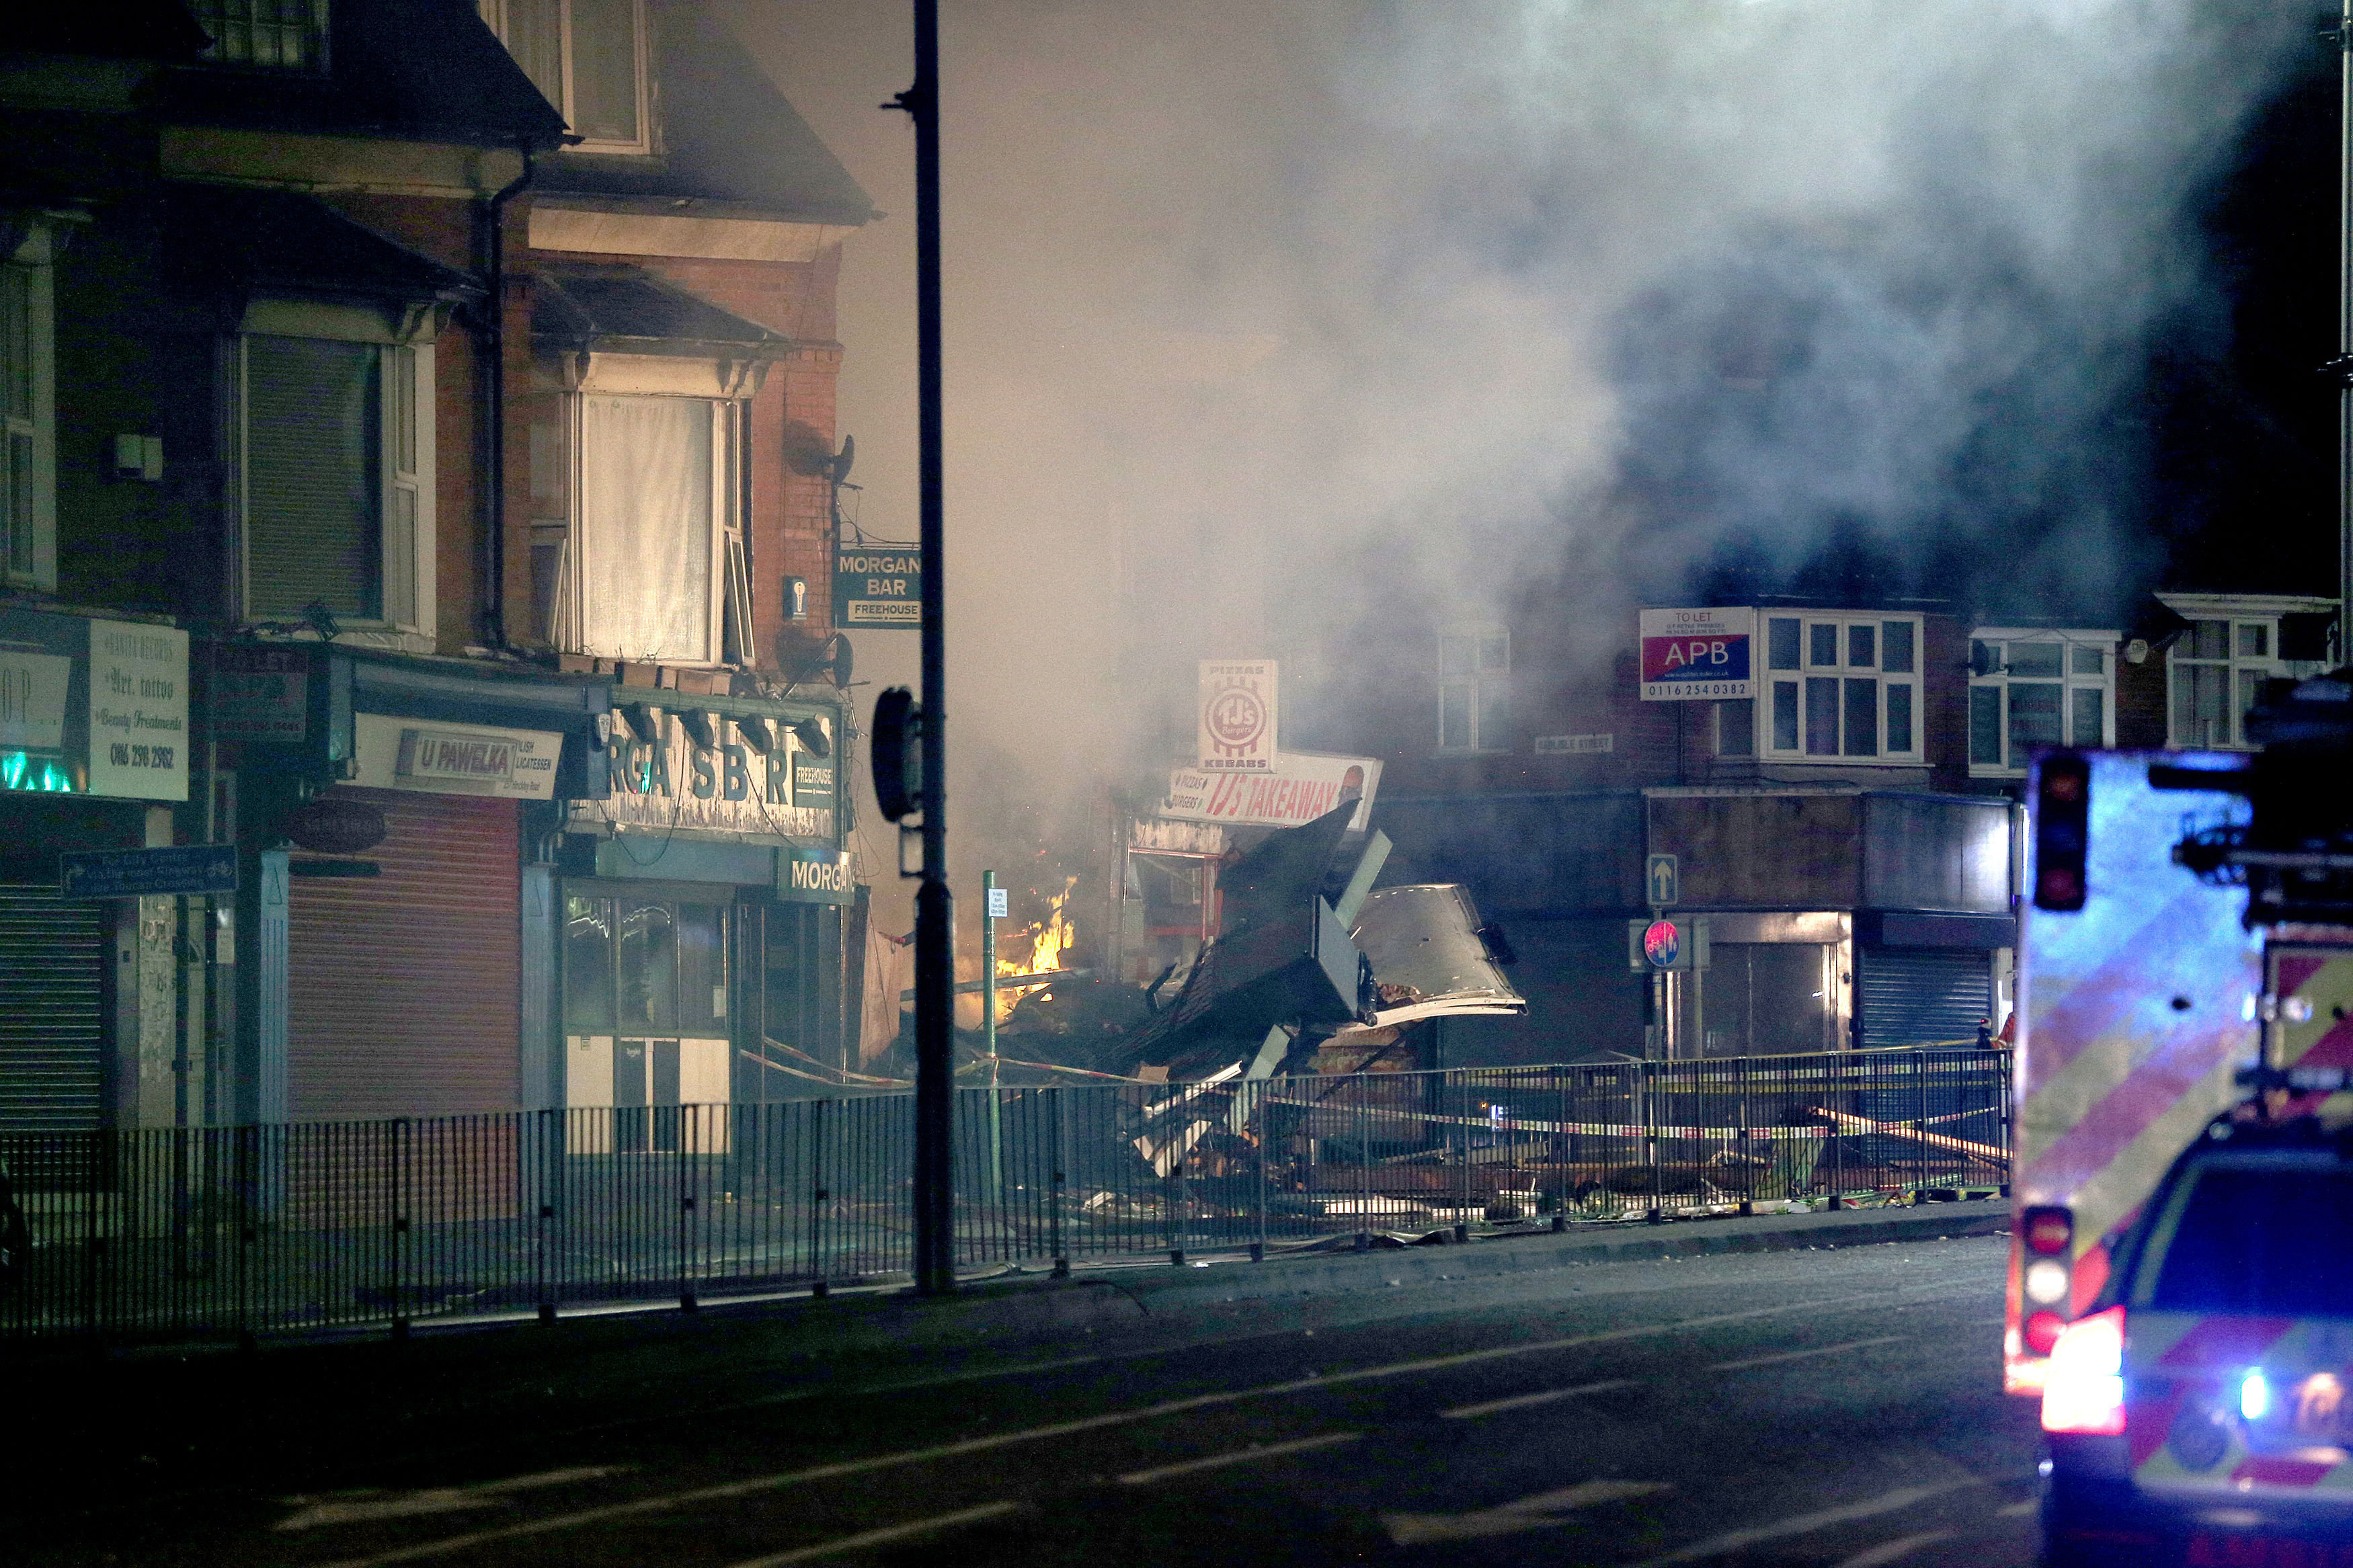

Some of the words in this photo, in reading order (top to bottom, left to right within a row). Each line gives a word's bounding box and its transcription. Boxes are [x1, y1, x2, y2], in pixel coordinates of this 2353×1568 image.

[839, 556, 920, 574] MORGAN
[867, 579, 906, 595] BAR
[854, 605, 918, 615] FREEHOUSE
[1675, 612, 1690, 622] TO
[1693, 612, 1712, 622] LET
[1665, 641, 1729, 665] APB
[1209, 666, 1265, 675] PIZZAS
[2, 668, 31, 724] OP
[1649, 686, 1681, 696] 0116
[1686, 685, 1708, 695] 254
[1713, 684, 1745, 695] 0382
[1218, 698, 1256, 727] TJ's
[99, 708, 132, 734] Beauty
[134, 710, 182, 731] Treatments
[1221, 727, 1252, 735] Burgers
[518, 741, 534, 754] LISH
[131, 744, 150, 768] 298
[151, 746, 175, 770] 2982
[516, 757, 552, 771] LICATESSEN
[1204, 759, 1267, 768] KEBABS
[796, 766, 832, 784] FREEHOUSE
[1181, 774, 1203, 790] PIZZAS
[1245, 778, 1339, 819] TAKEAWAY
